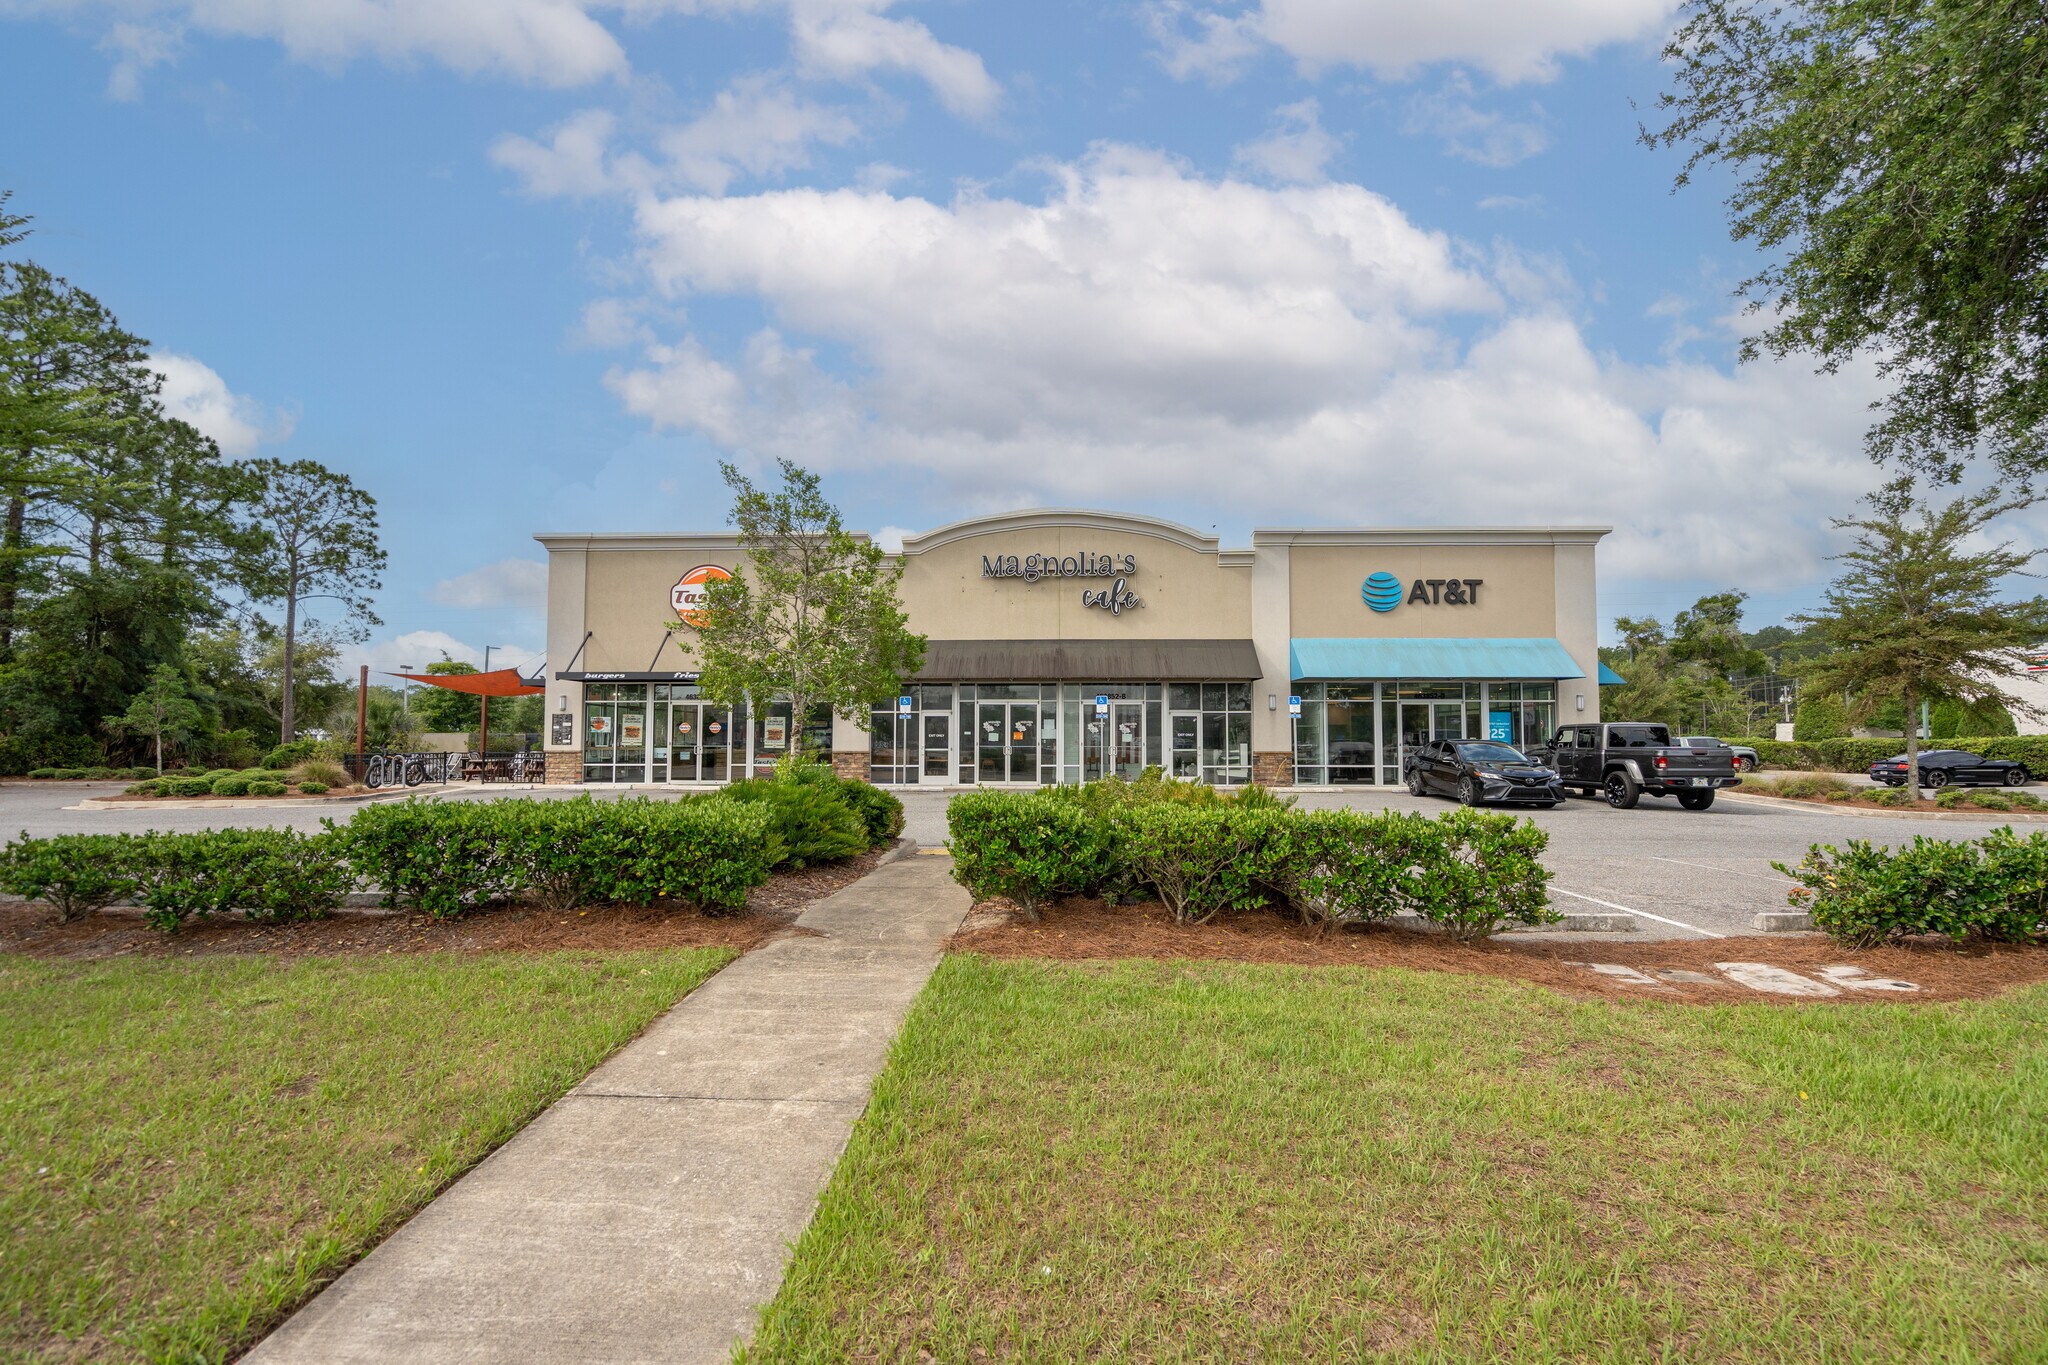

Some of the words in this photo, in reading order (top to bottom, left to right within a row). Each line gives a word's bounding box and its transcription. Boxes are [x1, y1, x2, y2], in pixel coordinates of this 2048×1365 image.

[981, 551, 1137, 582] Magnolia's
[1081, 577, 1139, 616] cafe
[1407, 578, 1483, 605] AT&T
[673, 671, 700, 679] fries
[1491, 728, 1506, 739] 25
